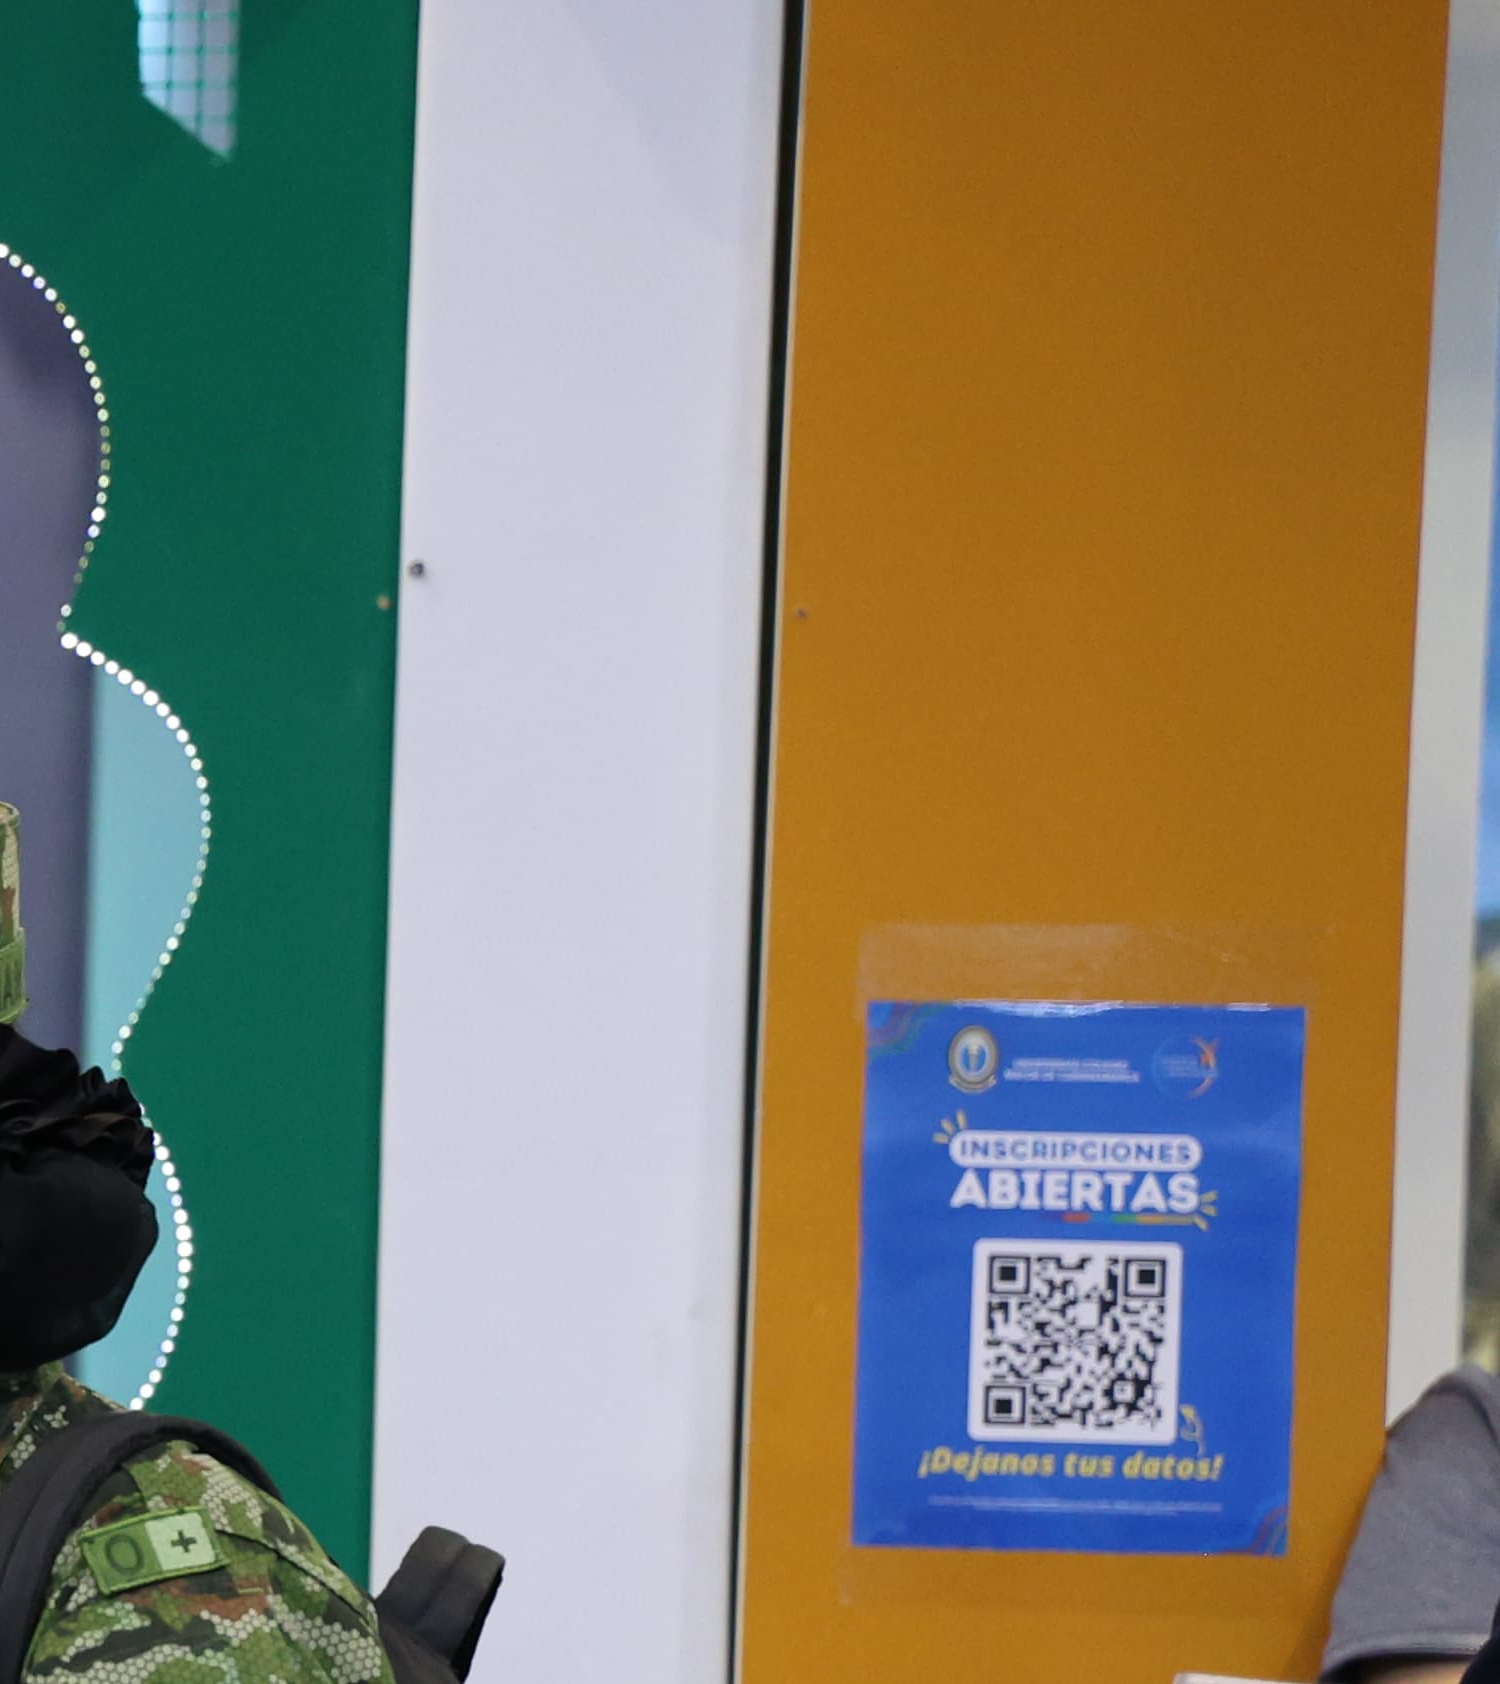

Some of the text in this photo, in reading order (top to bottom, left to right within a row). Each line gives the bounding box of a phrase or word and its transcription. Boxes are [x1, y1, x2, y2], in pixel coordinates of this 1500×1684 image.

[958, 1137, 1192, 1165] INSCRIPCIONES
[949, 1167, 1202, 1214] ABIERTAS
[1063, 1453, 1114, 1478] tus
[1121, 1452, 1224, 1480] datos!
